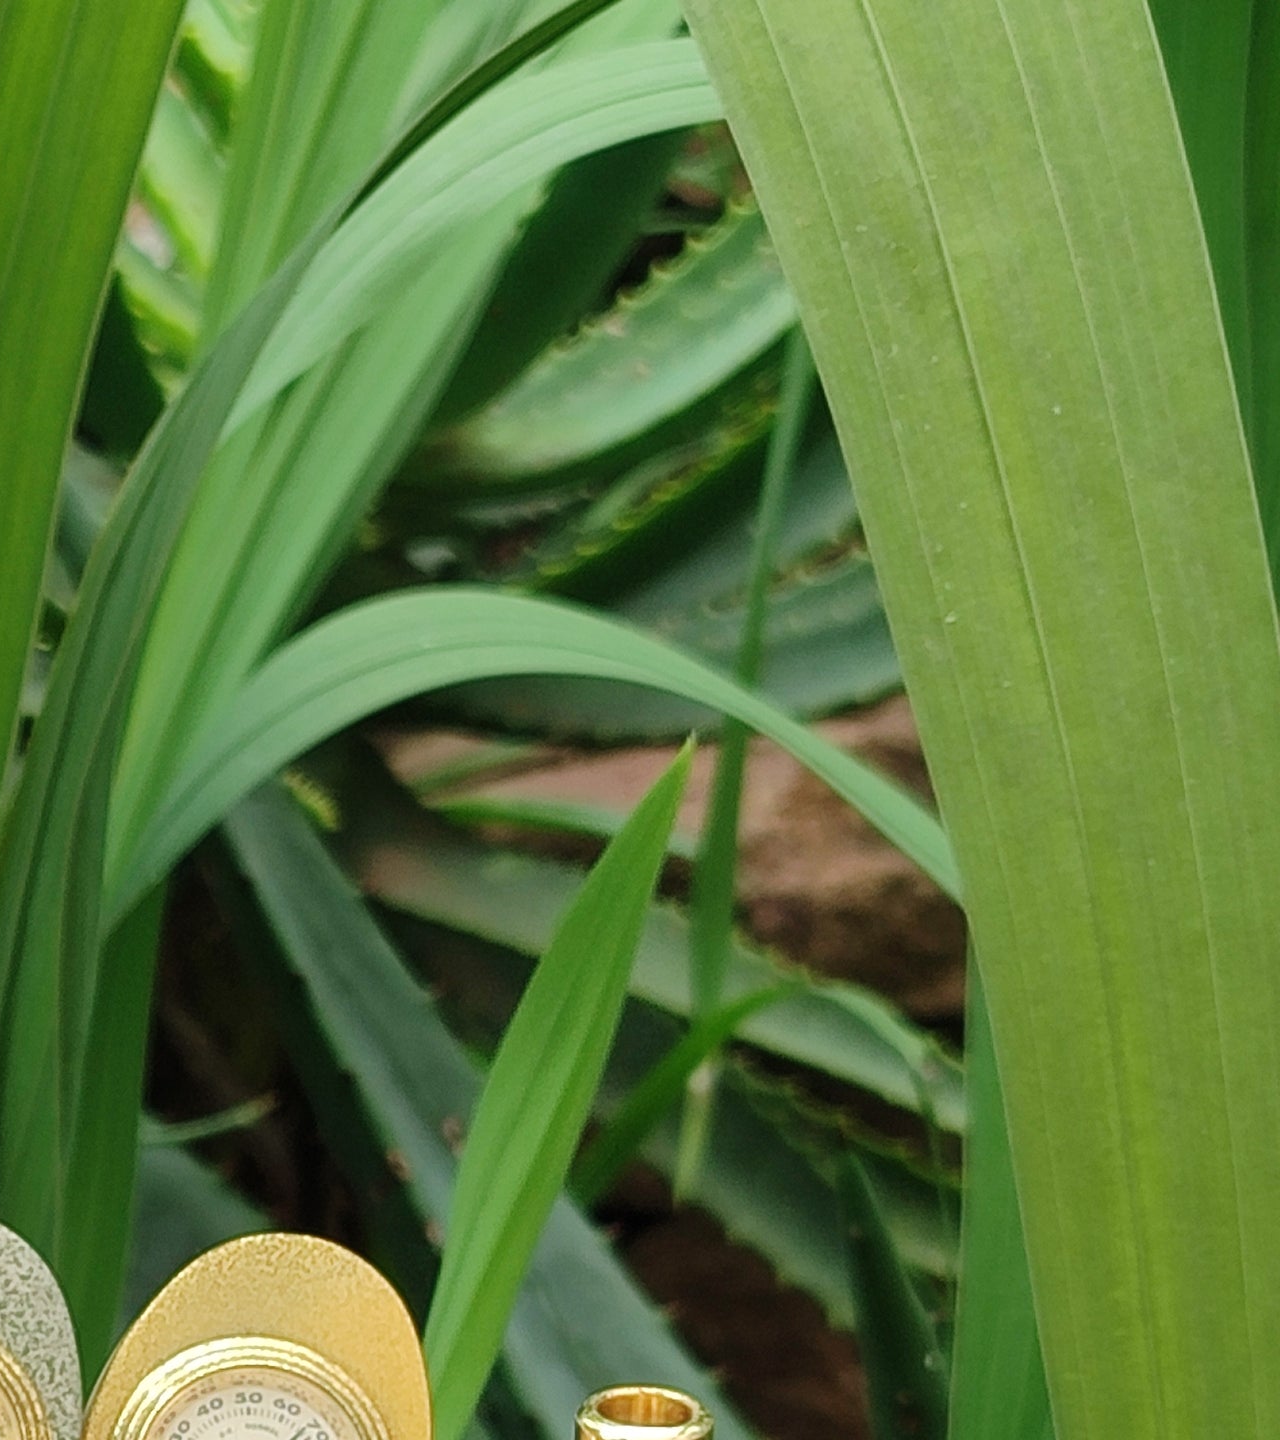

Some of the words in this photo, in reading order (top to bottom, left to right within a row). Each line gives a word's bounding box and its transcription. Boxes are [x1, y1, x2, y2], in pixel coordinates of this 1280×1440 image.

[235, 1392, 263, 1405] 50
[197, 1398, 223, 1417] 40
[273, 1399, 301, 1416] 60
